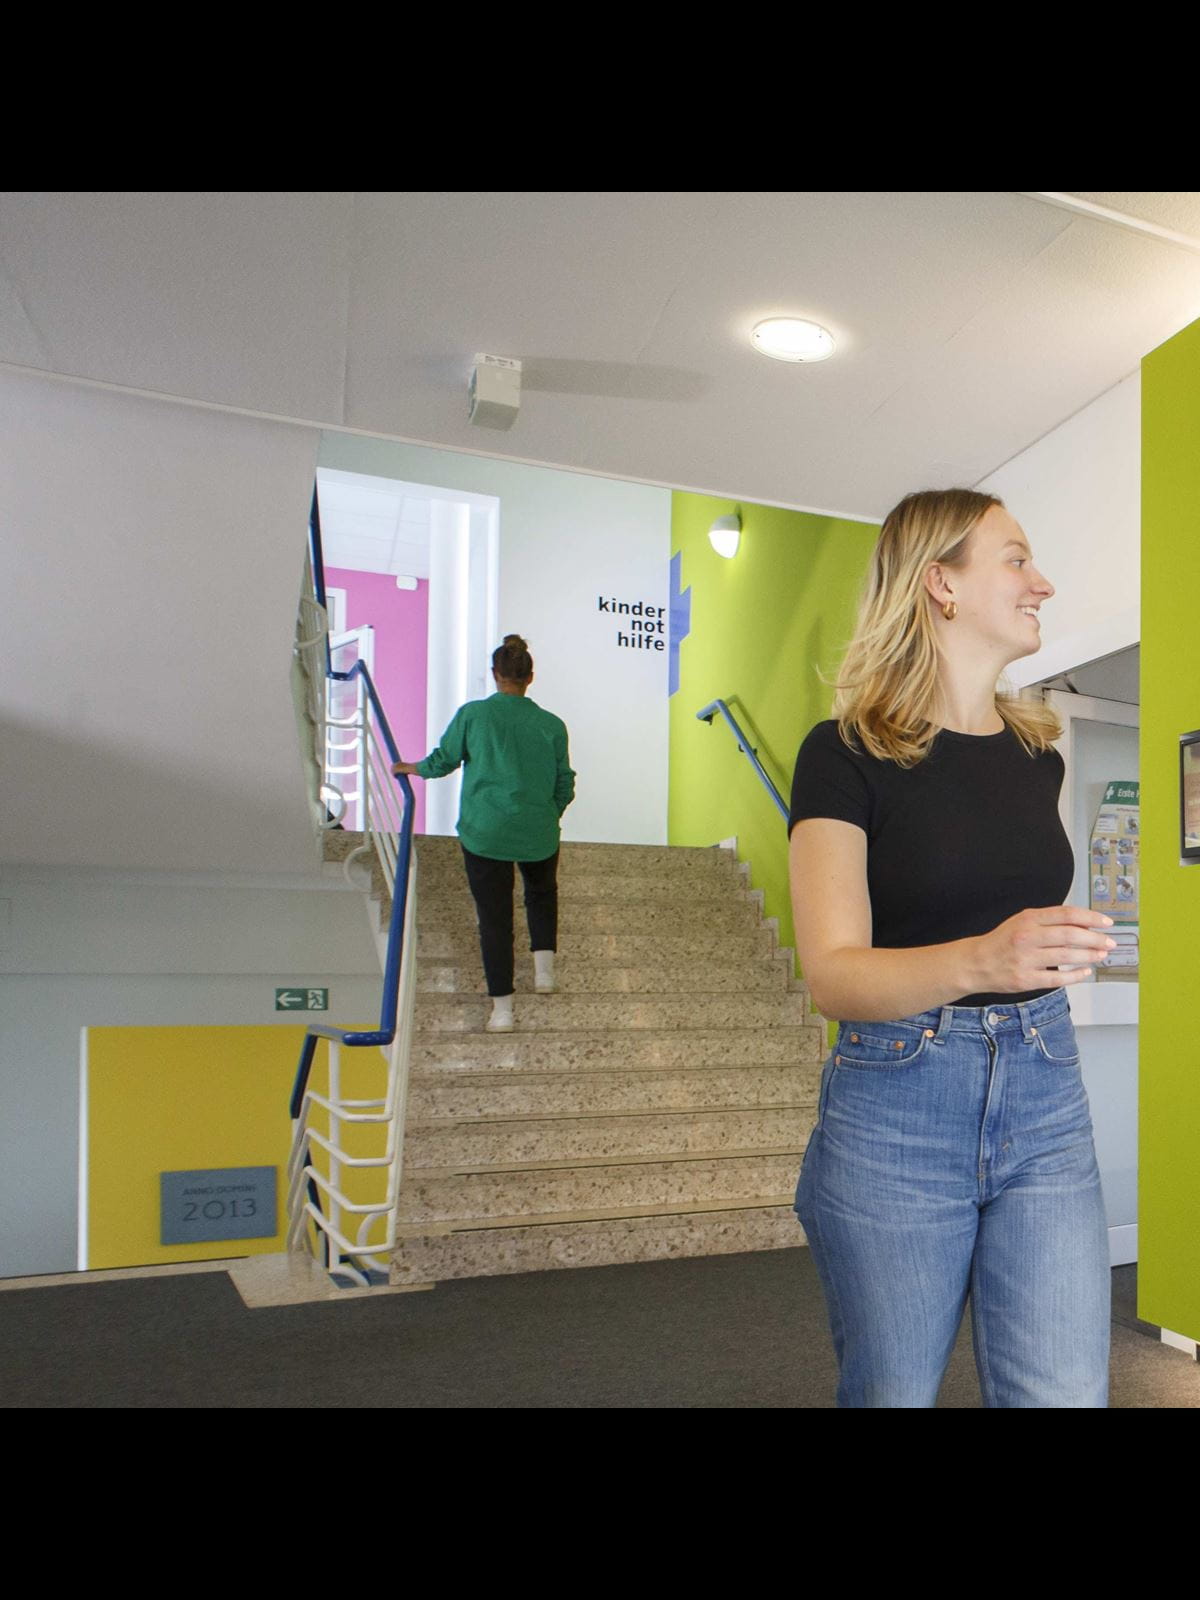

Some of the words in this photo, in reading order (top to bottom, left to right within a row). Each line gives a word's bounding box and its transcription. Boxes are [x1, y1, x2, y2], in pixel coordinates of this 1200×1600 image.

[598, 596, 666, 618] kinder
[631, 620, 665, 634] not
[617, 631, 665, 651] hilfe
[182, 1198, 257, 1222] 2013
